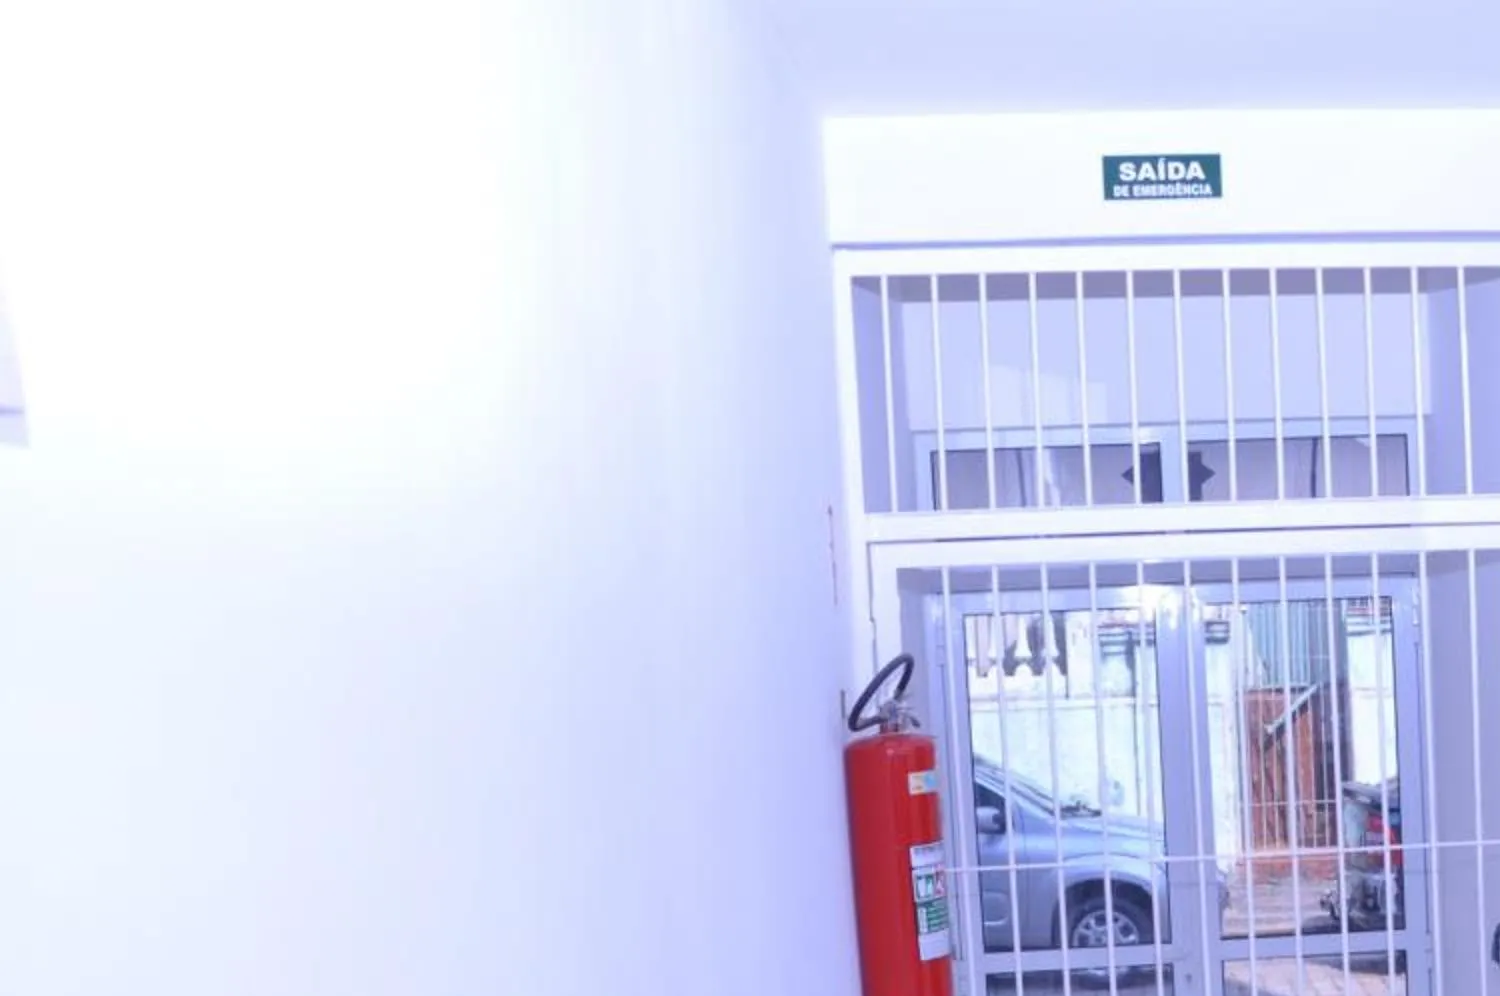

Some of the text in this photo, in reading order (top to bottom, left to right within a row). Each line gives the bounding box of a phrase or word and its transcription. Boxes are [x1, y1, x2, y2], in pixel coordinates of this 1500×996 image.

[1119, 158, 1206, 181] SAÍDA
[1113, 182, 1212, 197] DE EMERGÊNCIA
